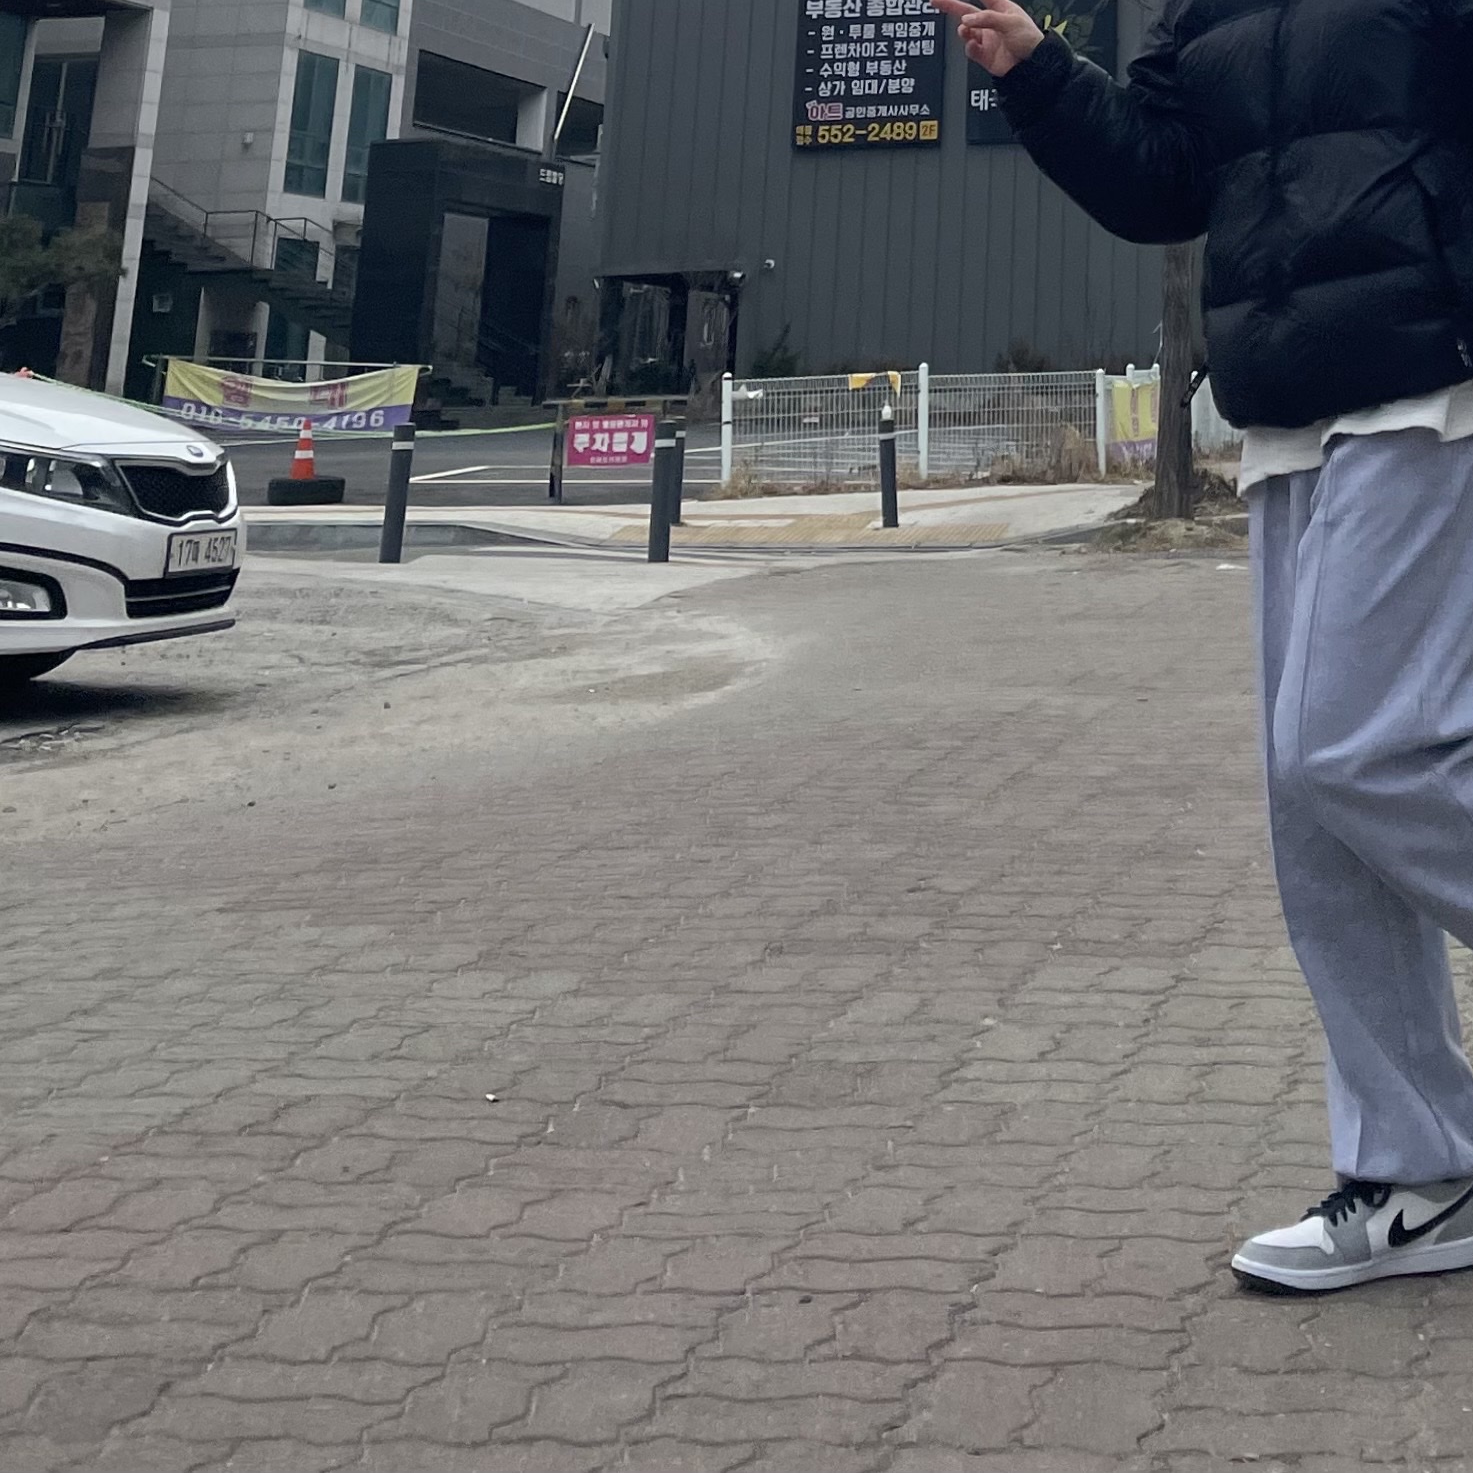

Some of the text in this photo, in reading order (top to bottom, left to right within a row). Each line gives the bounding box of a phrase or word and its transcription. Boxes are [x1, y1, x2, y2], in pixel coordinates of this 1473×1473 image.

[881, 21, 936, 38] 책임중개
[820, 39, 935, 59] 프렌차이즈 컨설팅
[819, 59, 907, 78] 수익형 부동산
[818, 78, 916, 97] 상가 임대/분양
[806, 102, 931, 121] 아트 공인중개사사무소
[817, 121, 917, 144] 552-2489
